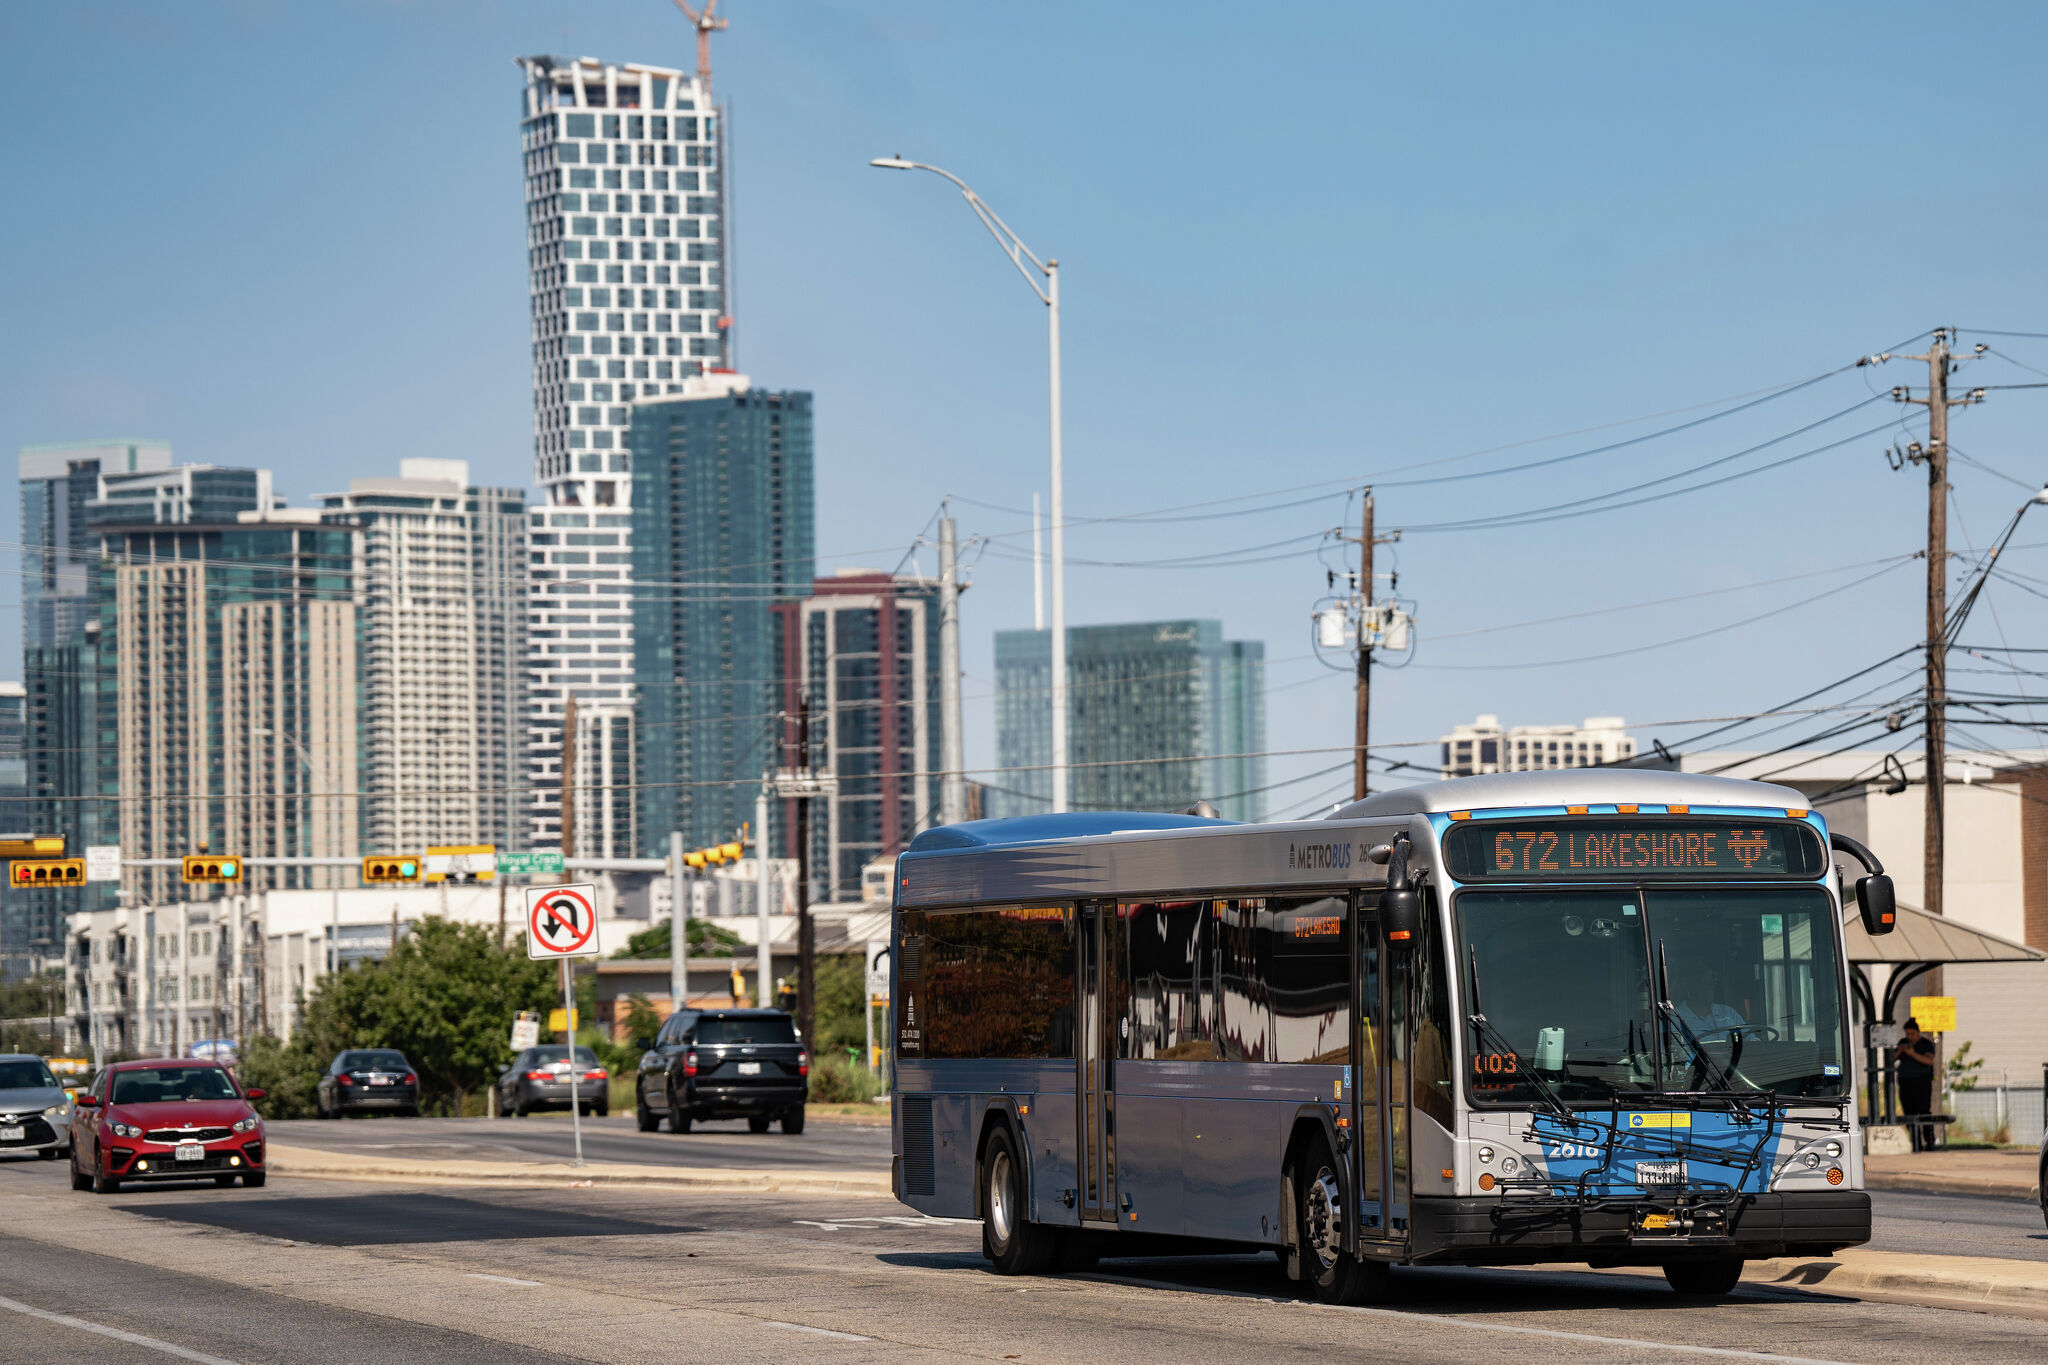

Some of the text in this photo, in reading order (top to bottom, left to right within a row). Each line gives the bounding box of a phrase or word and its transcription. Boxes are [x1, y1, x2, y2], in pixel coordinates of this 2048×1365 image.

[500, 854, 561, 866] Royal Crest
[1297, 843, 1375, 869] METROBUS 261
[1495, 831, 1559, 870] 672
[1569, 832, 1717, 867] LAKESHORE
[1295, 916, 1341, 938] 672 LAKESHO
[1548, 1138, 1599, 1158] 2616
